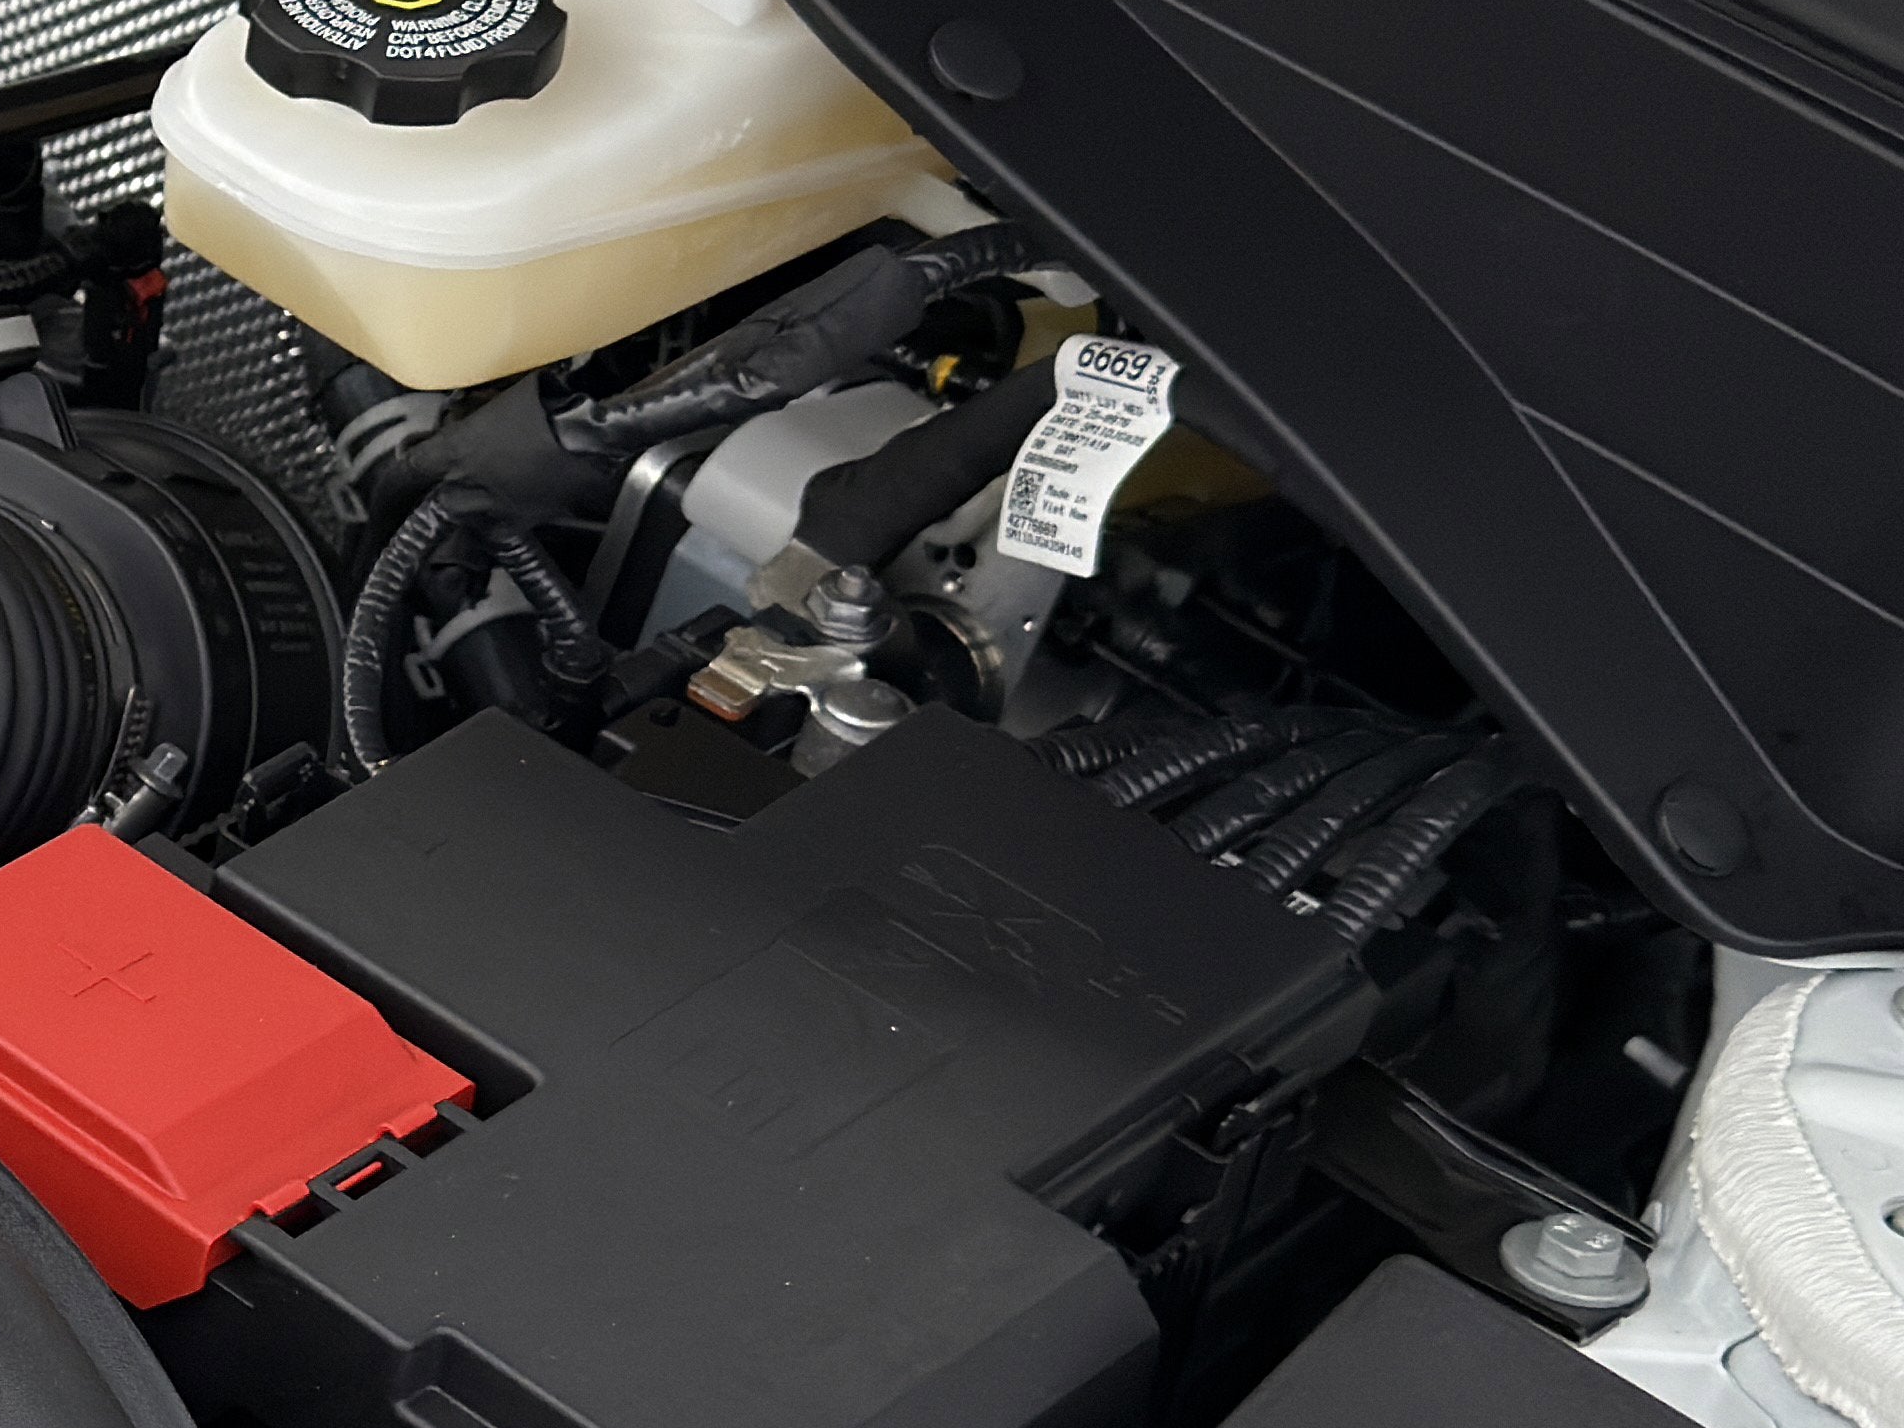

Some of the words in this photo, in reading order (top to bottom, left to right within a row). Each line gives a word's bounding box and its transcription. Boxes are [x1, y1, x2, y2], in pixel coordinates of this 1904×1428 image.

[386, 45, 423, 59] DOT
[424, 46, 438, 59] 4
[436, 38, 487, 58] FLUID
[388, 33, 425, 45] CAP
[1078, 341, 1153, 381] 6669
